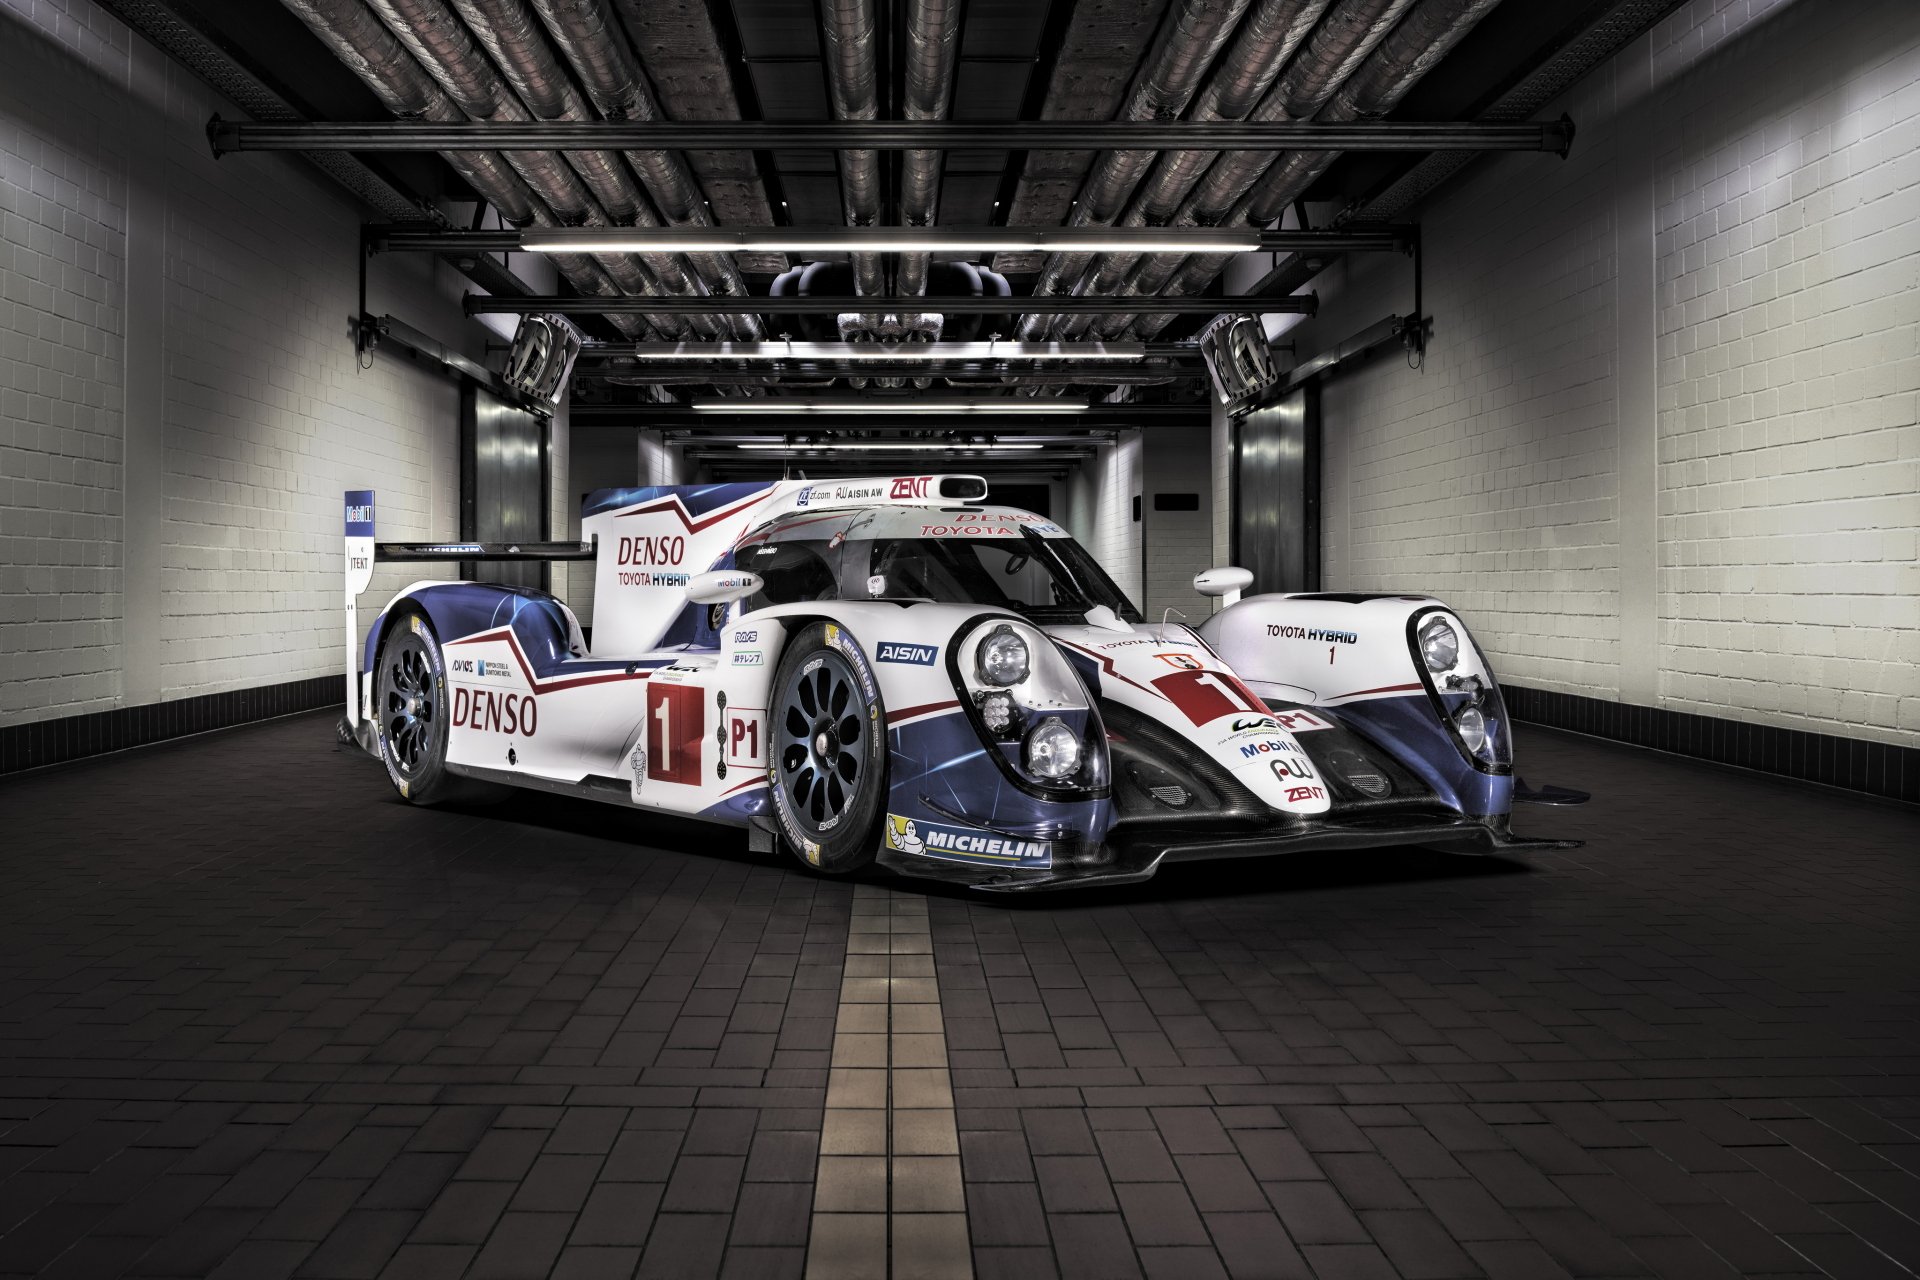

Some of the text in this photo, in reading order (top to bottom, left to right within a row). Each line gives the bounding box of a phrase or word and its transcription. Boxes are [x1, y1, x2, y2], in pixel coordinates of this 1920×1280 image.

[810, 490, 831, 500] zf.com
[848, 489, 869, 499] AISIN
[870, 488, 883, 498] AW
[889, 477, 933, 499] ZENT
[346, 505, 364, 523] Mobil
[955, 514, 1045, 523] DENSO
[920, 525, 1015, 536] TOYOTA
[617, 536, 685, 566] DENSO
[350, 557, 369, 571] JTEKT
[618, 572, 651, 587] TOYOTA
[717, 578, 741, 588] Mobil
[734, 630, 758, 643] RAYS
[1266, 624, 1358, 645] TOYOTA HYBRID
[879, 646, 933, 662] AISIN
[1098, 640, 1147, 650] TOYOTA
[1329, 645, 1336, 665] 1
[842, 638, 875, 699] MICHELIN
[1194, 672, 1253, 712] 1
[452, 687, 538, 738] DENSO
[1275, 712, 1321, 729] P1
[655, 697, 671, 772] 1
[732, 718, 758, 758] P1
[1240, 740, 1290, 758] Mobil
[1283, 786, 1325, 803] ZENT
[773, 790, 803, 850] MICHELIN
[926, 830, 1047, 858] MICHELIN
